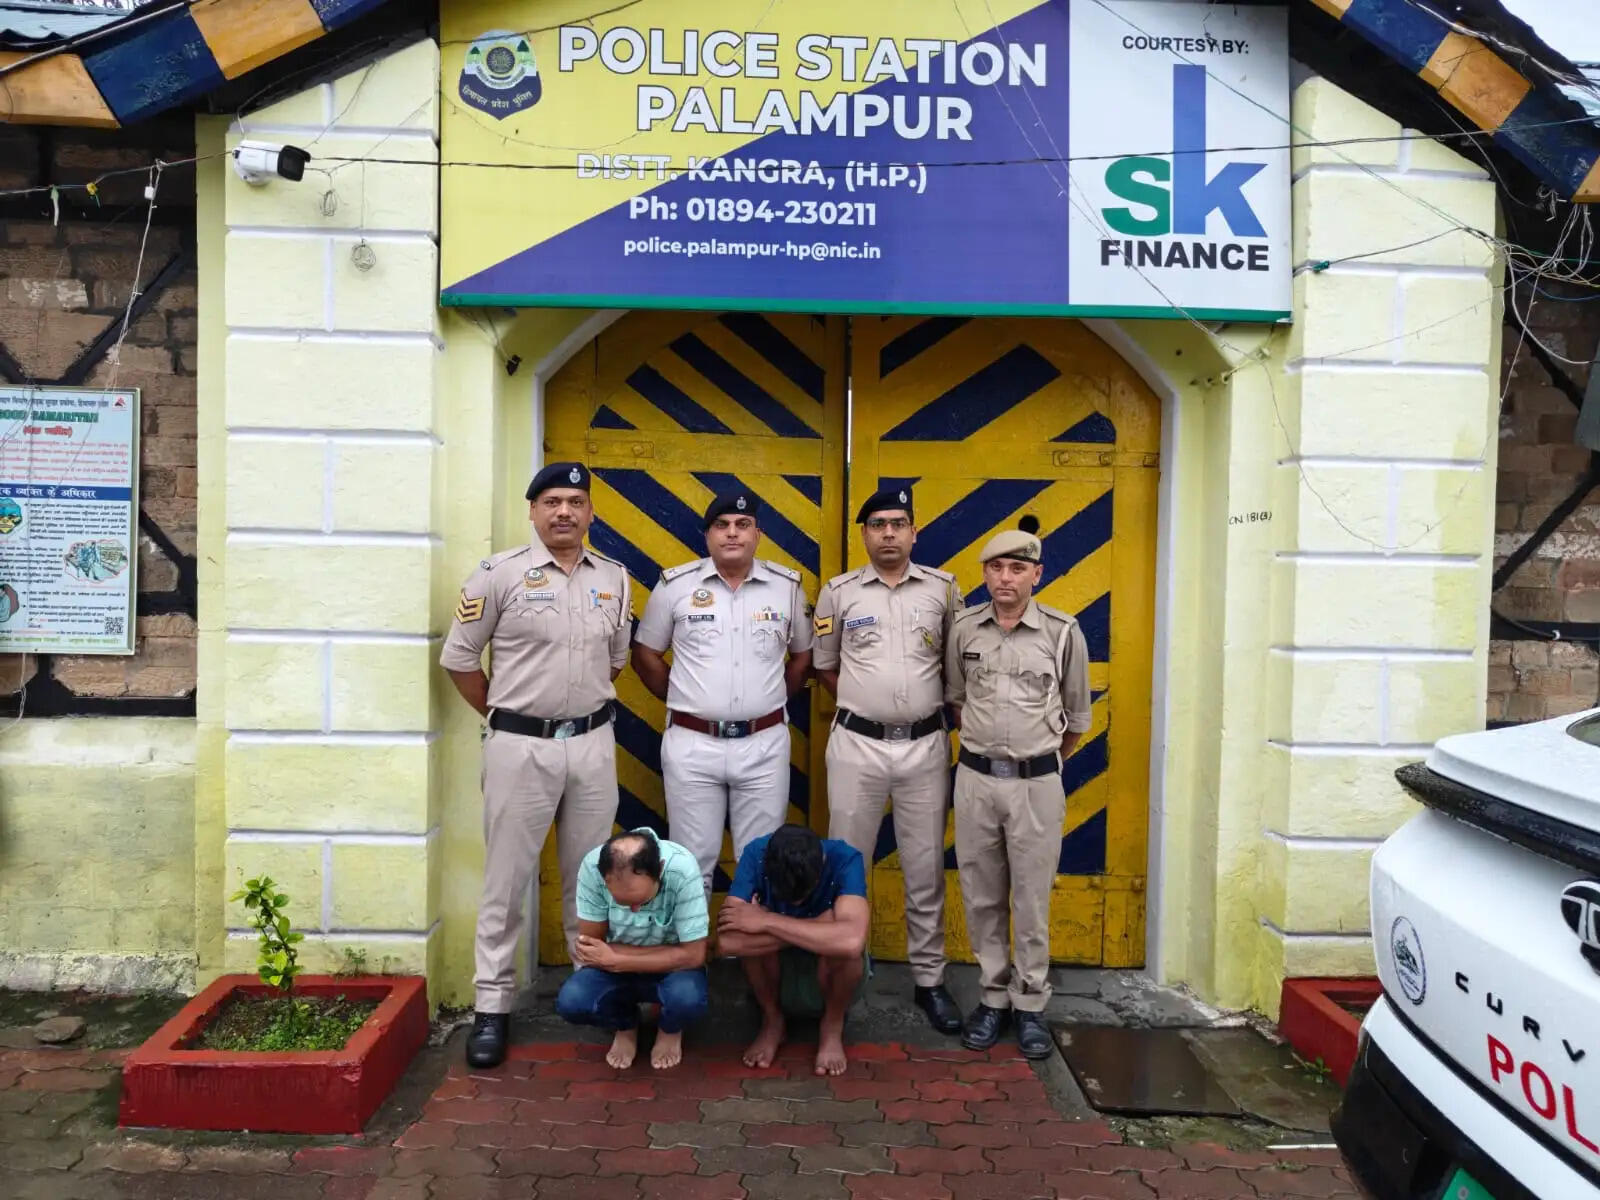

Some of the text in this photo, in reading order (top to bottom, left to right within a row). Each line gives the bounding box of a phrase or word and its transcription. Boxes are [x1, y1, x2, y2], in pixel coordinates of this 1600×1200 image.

[559, 25, 779, 79] POLICE
[795, 34, 1047, 87] STATION
[1122, 35, 1249, 54] COURTESY BY:
[637, 84, 974, 141] PALAMPUR
[577, 153, 927, 194] DISTT. KANGRA, (H.P.)
[629, 196, 876, 226] Ph: 01894-230211
[624, 236, 881, 261] police.palampur-hp@nic.in
[1101, 239, 1269, 271] FINANCE
